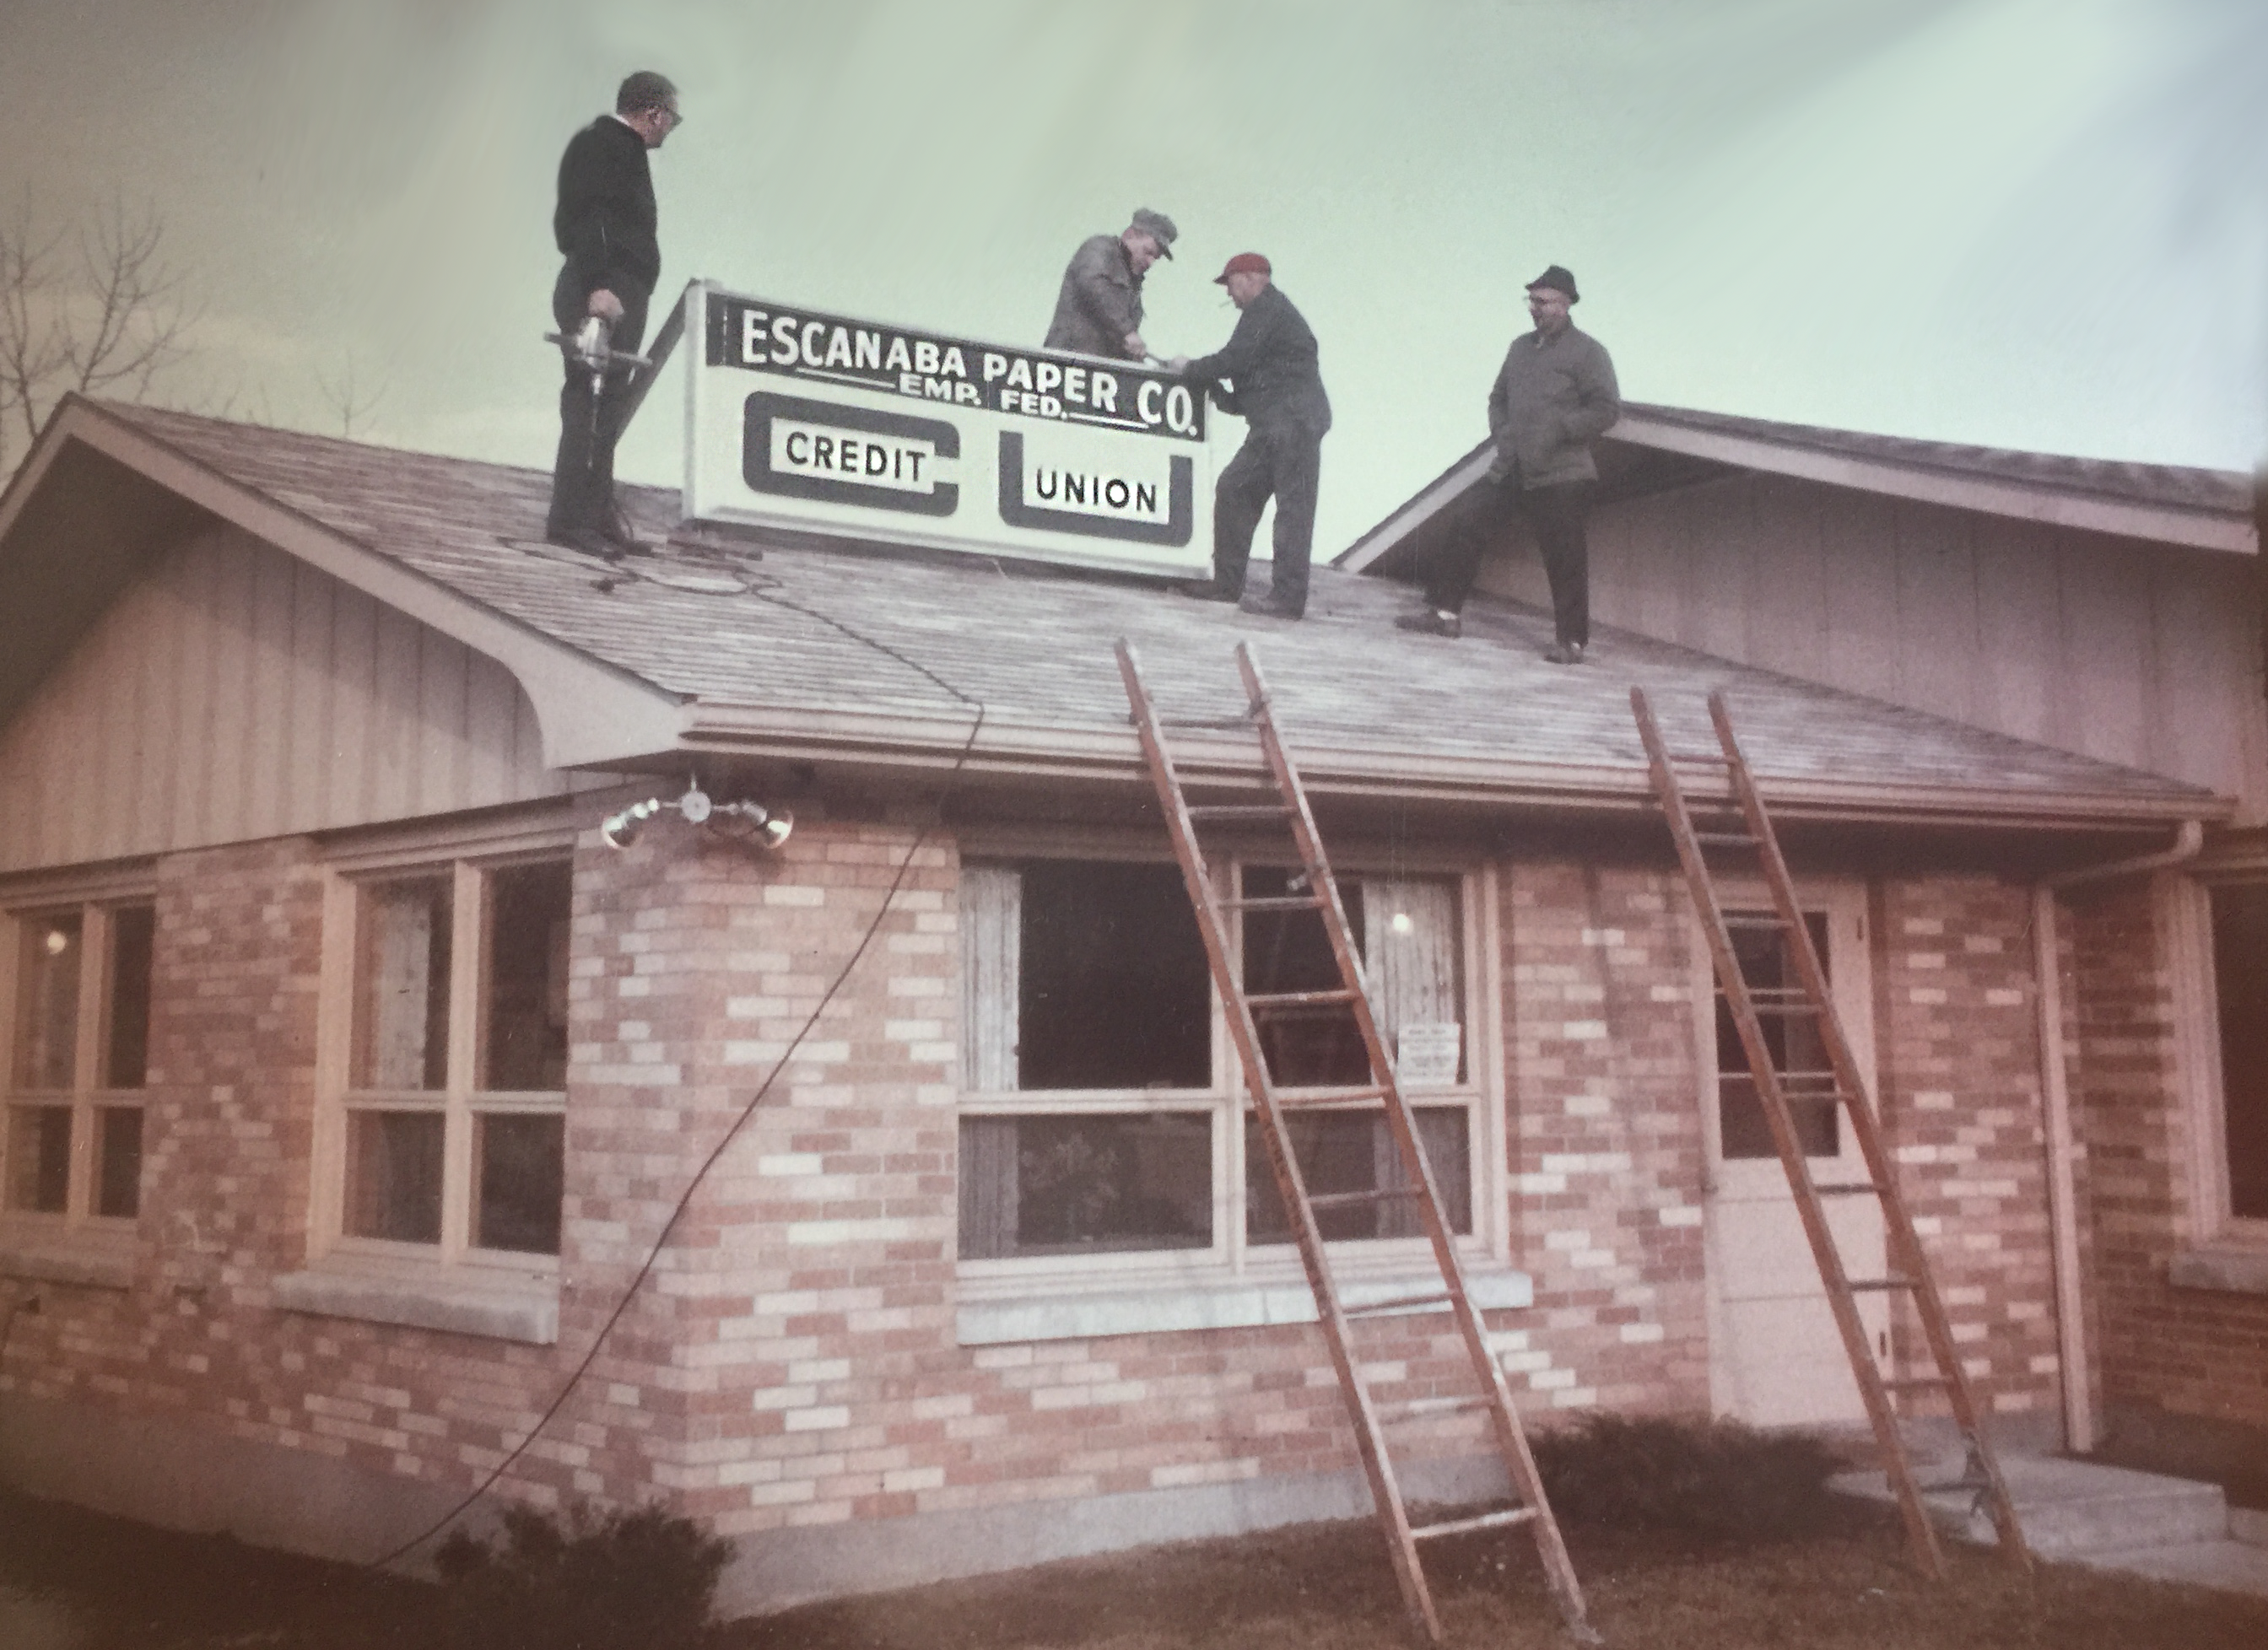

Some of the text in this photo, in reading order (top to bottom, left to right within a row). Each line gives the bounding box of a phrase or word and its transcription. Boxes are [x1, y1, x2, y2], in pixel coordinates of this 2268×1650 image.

[742, 309, 1198, 437] ESCANABA PAPER CO.
[899, 372, 1068, 420] EMP. FED.
[786, 431, 1158, 513] CREDIT UNION
